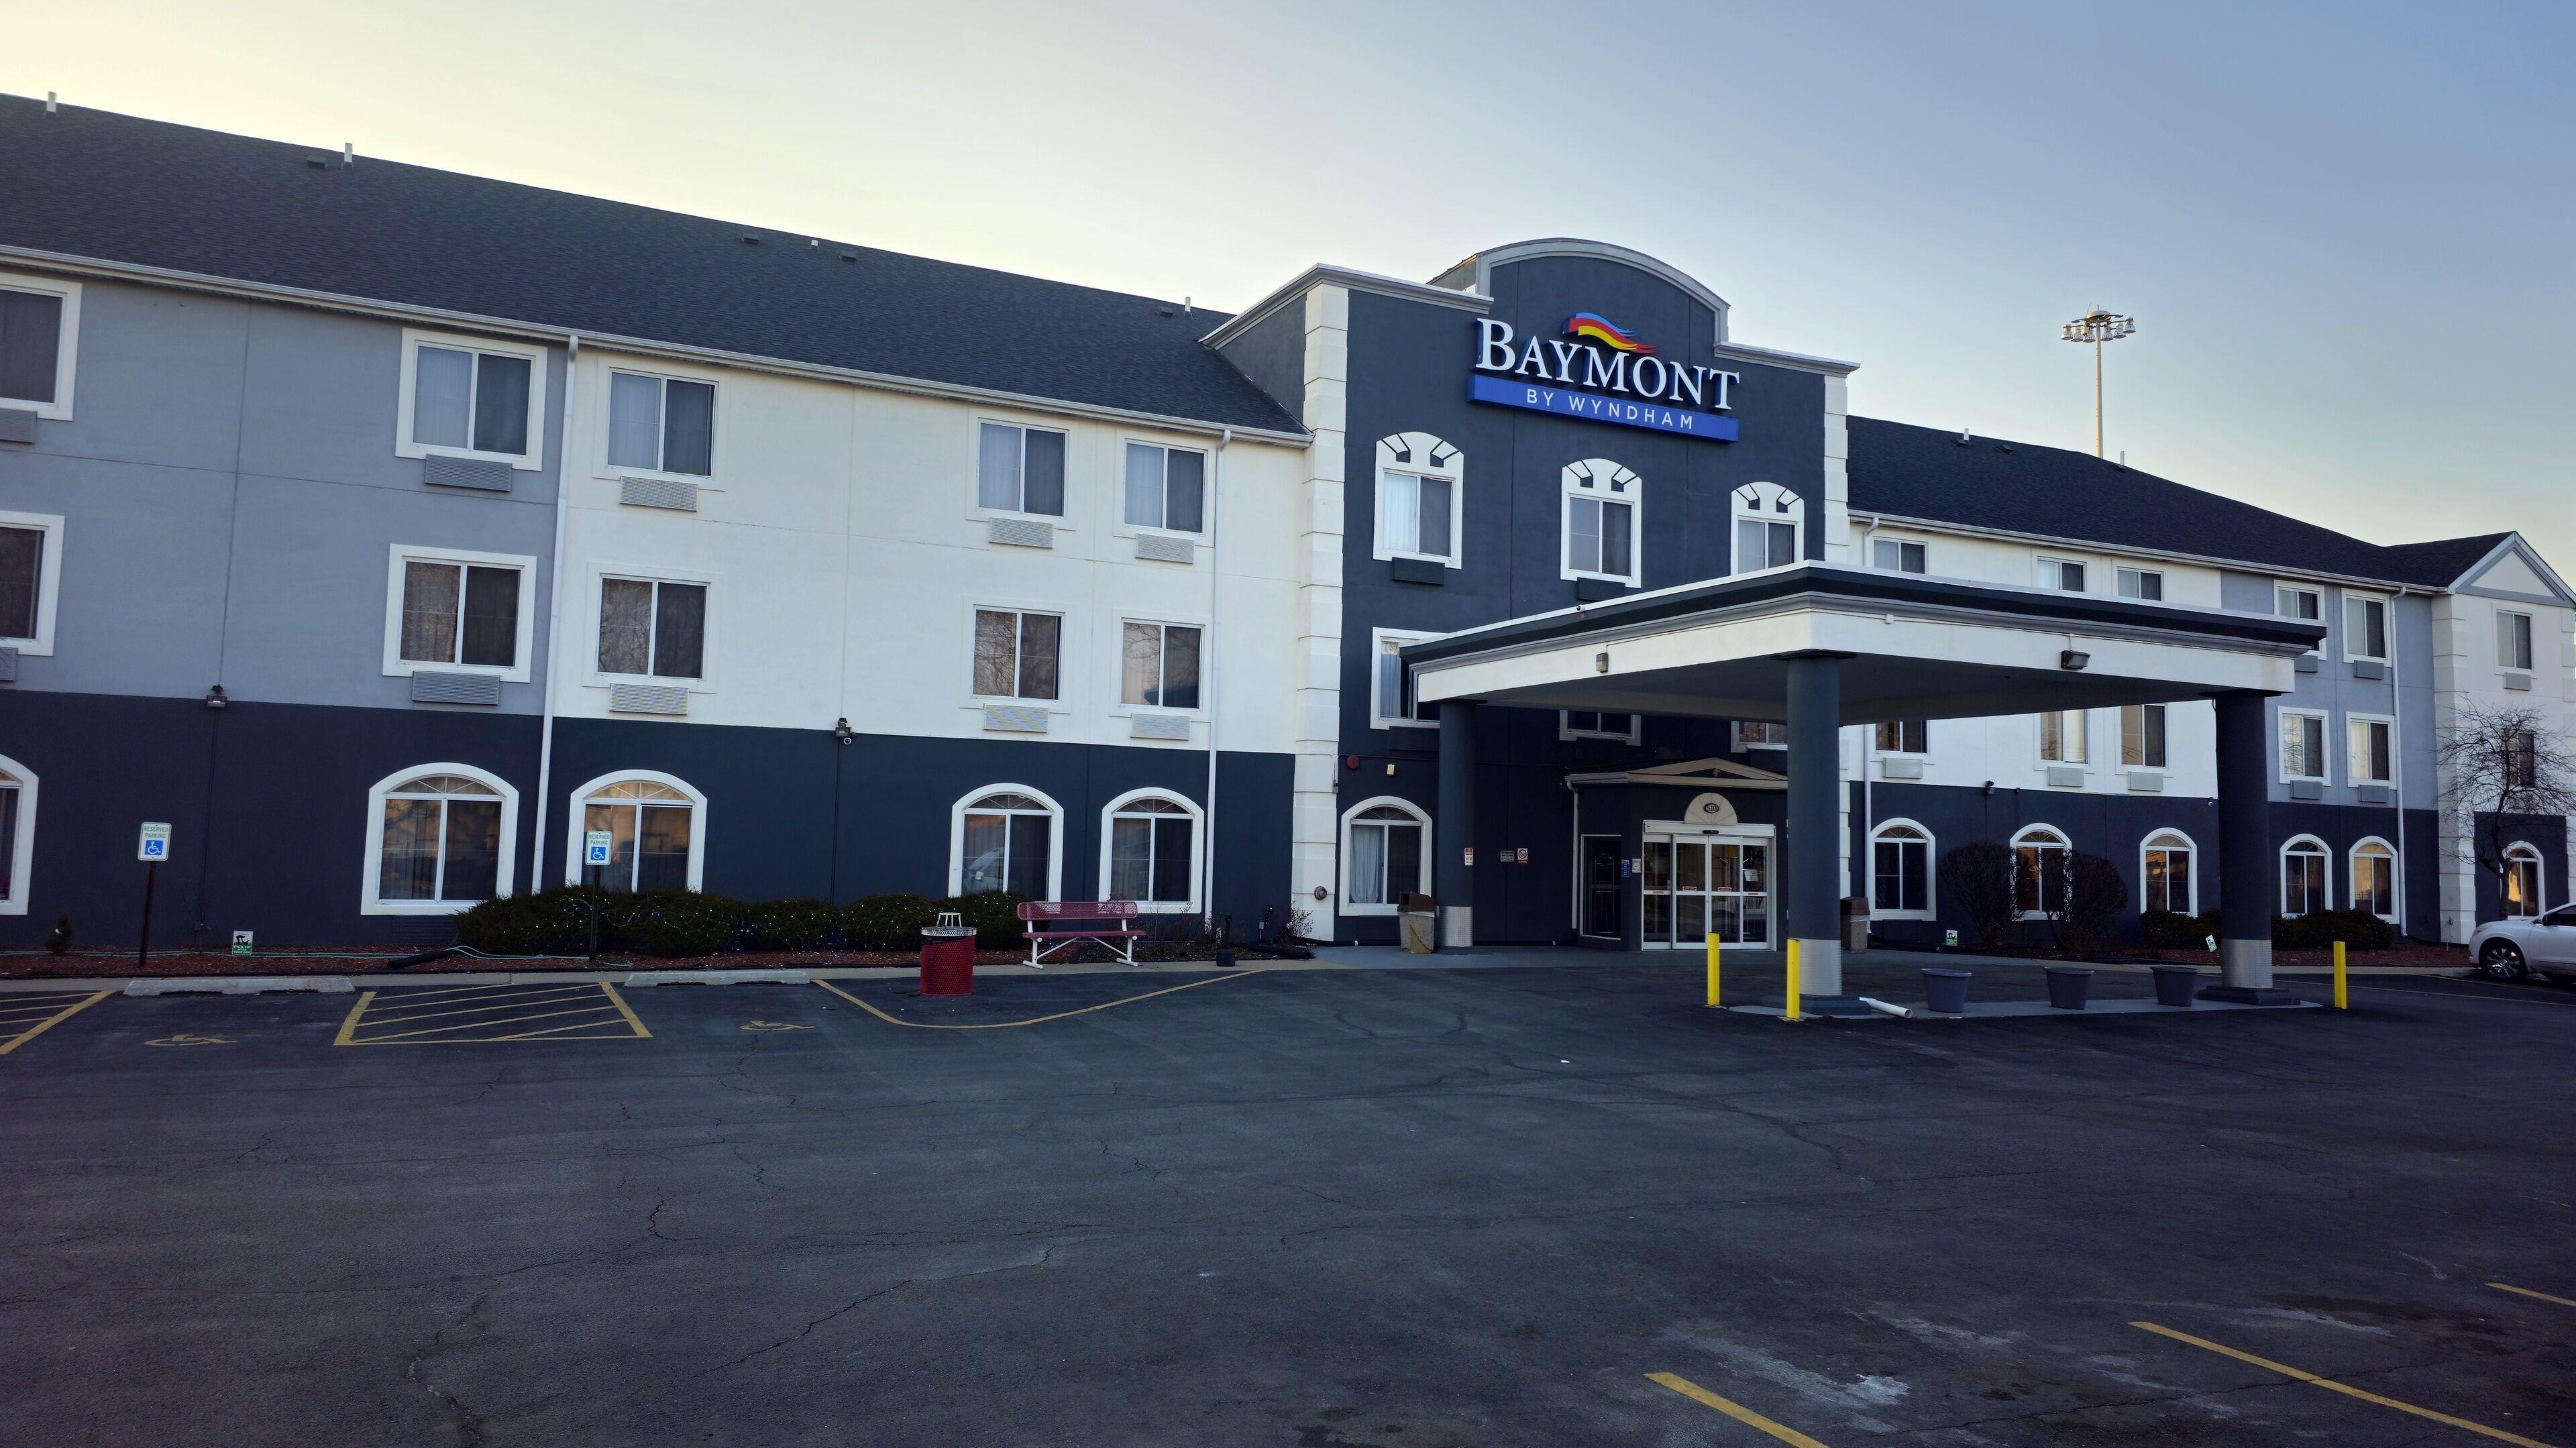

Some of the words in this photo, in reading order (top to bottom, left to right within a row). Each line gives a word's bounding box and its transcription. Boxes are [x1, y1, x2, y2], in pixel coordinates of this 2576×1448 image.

[1475, 317, 1739, 410] BAYMONT
[1526, 388, 1554, 406] BY
[1568, 395, 1693, 430] WYNDHAM
